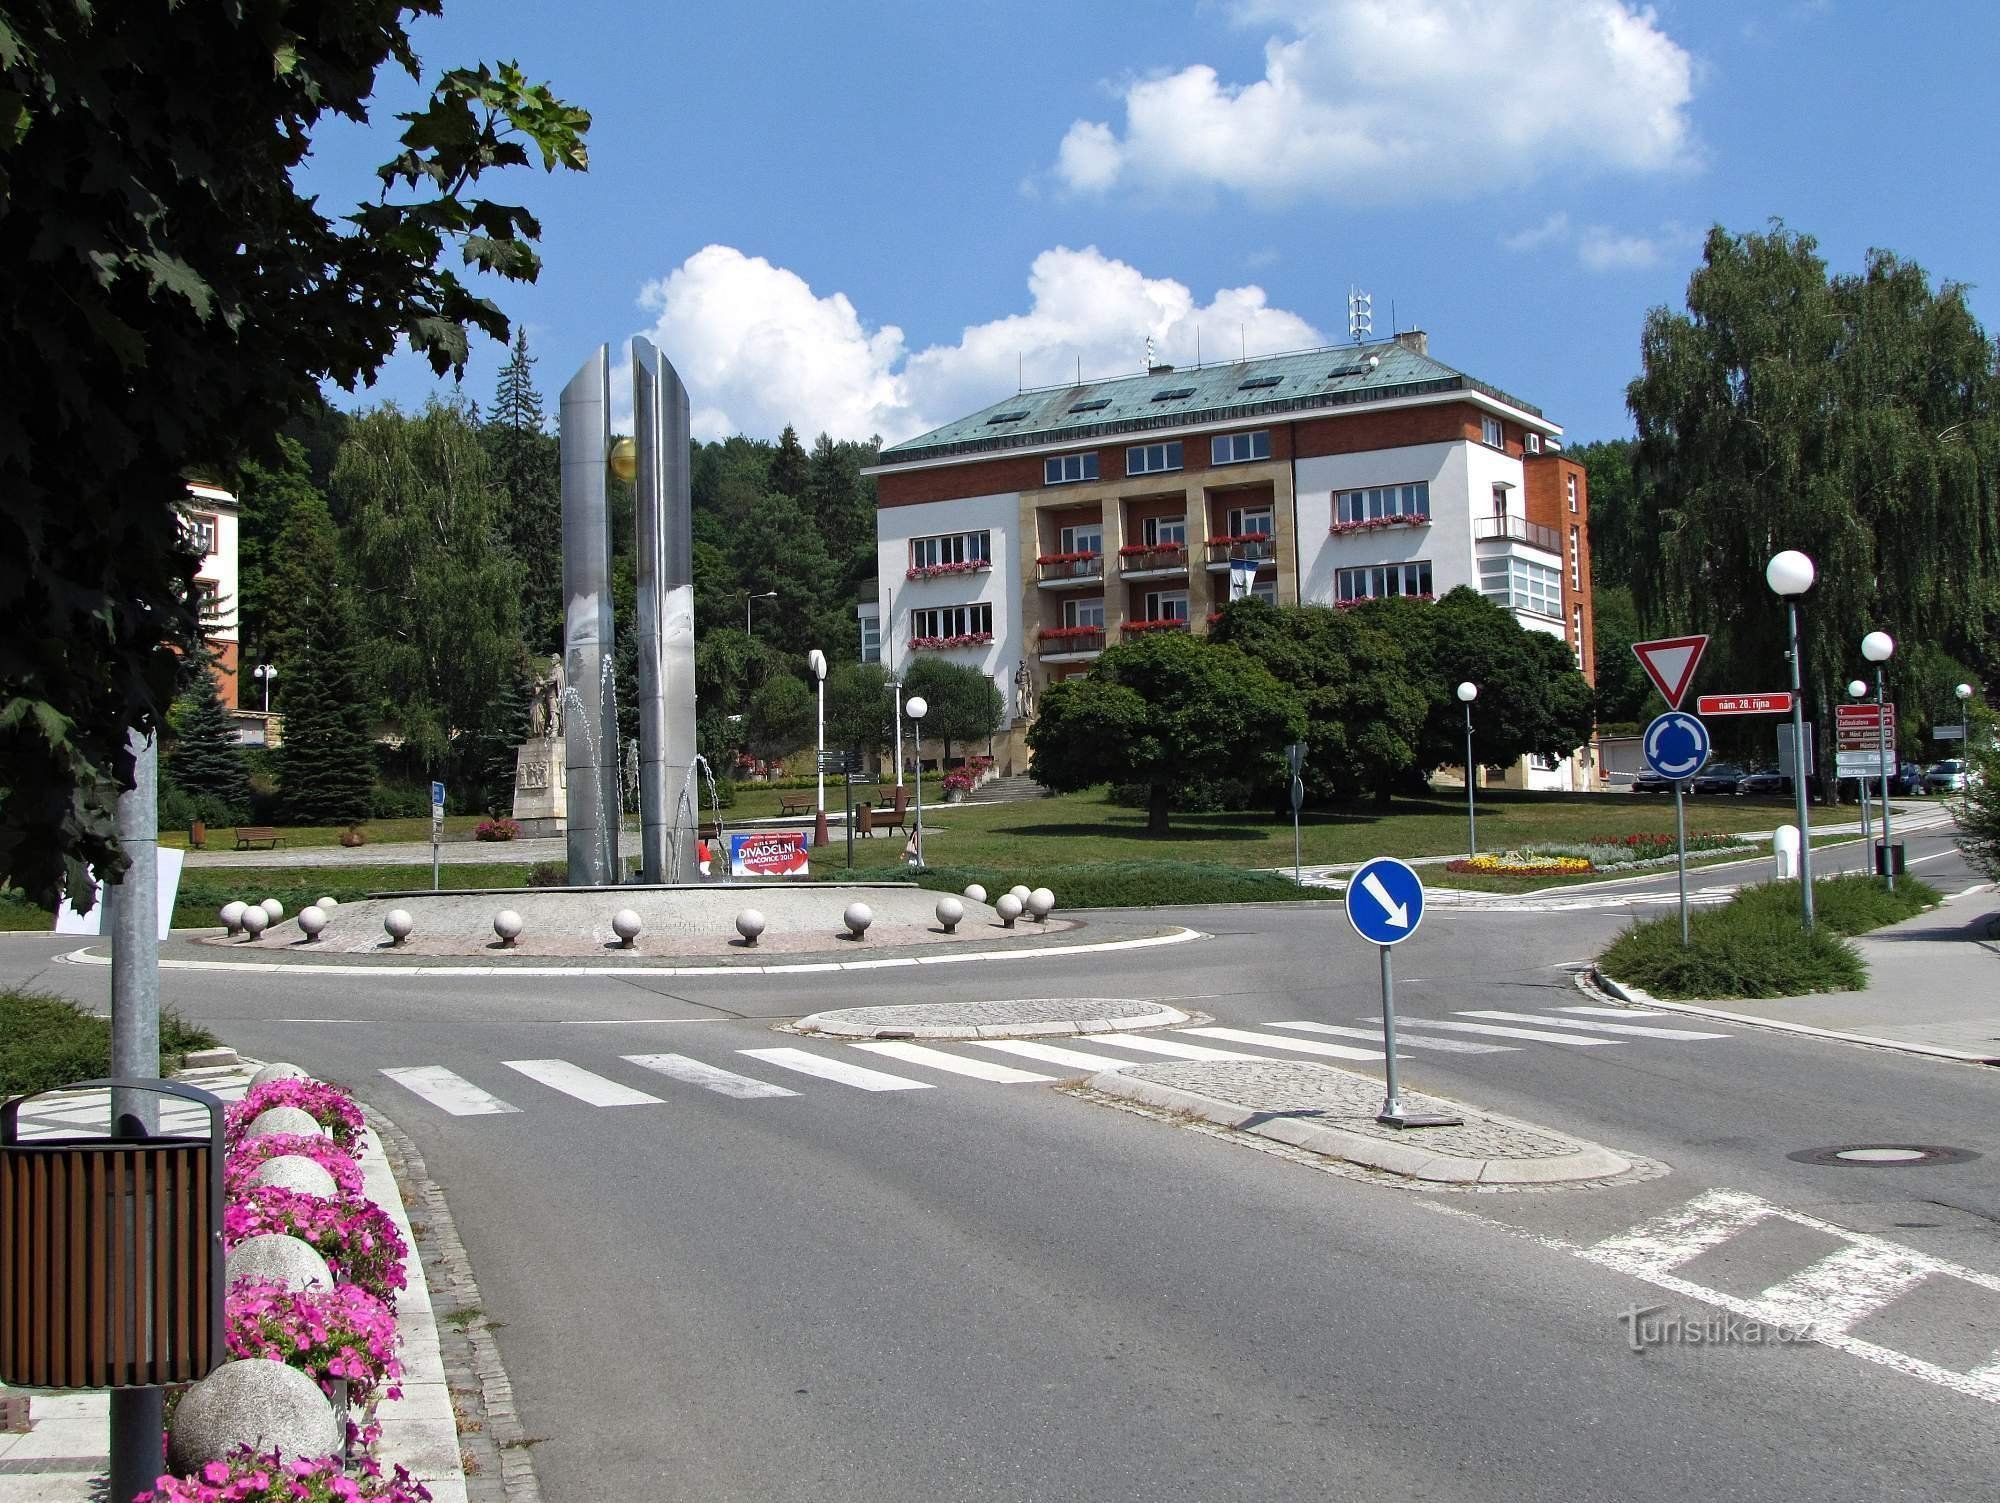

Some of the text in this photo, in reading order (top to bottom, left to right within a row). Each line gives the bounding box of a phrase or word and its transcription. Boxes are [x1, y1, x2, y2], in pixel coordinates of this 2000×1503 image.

[1718, 698, 1770, 711] nám. 28. října
[738, 840, 796, 859] DIVADELNÍ
[780, 853, 794, 861] 2015
